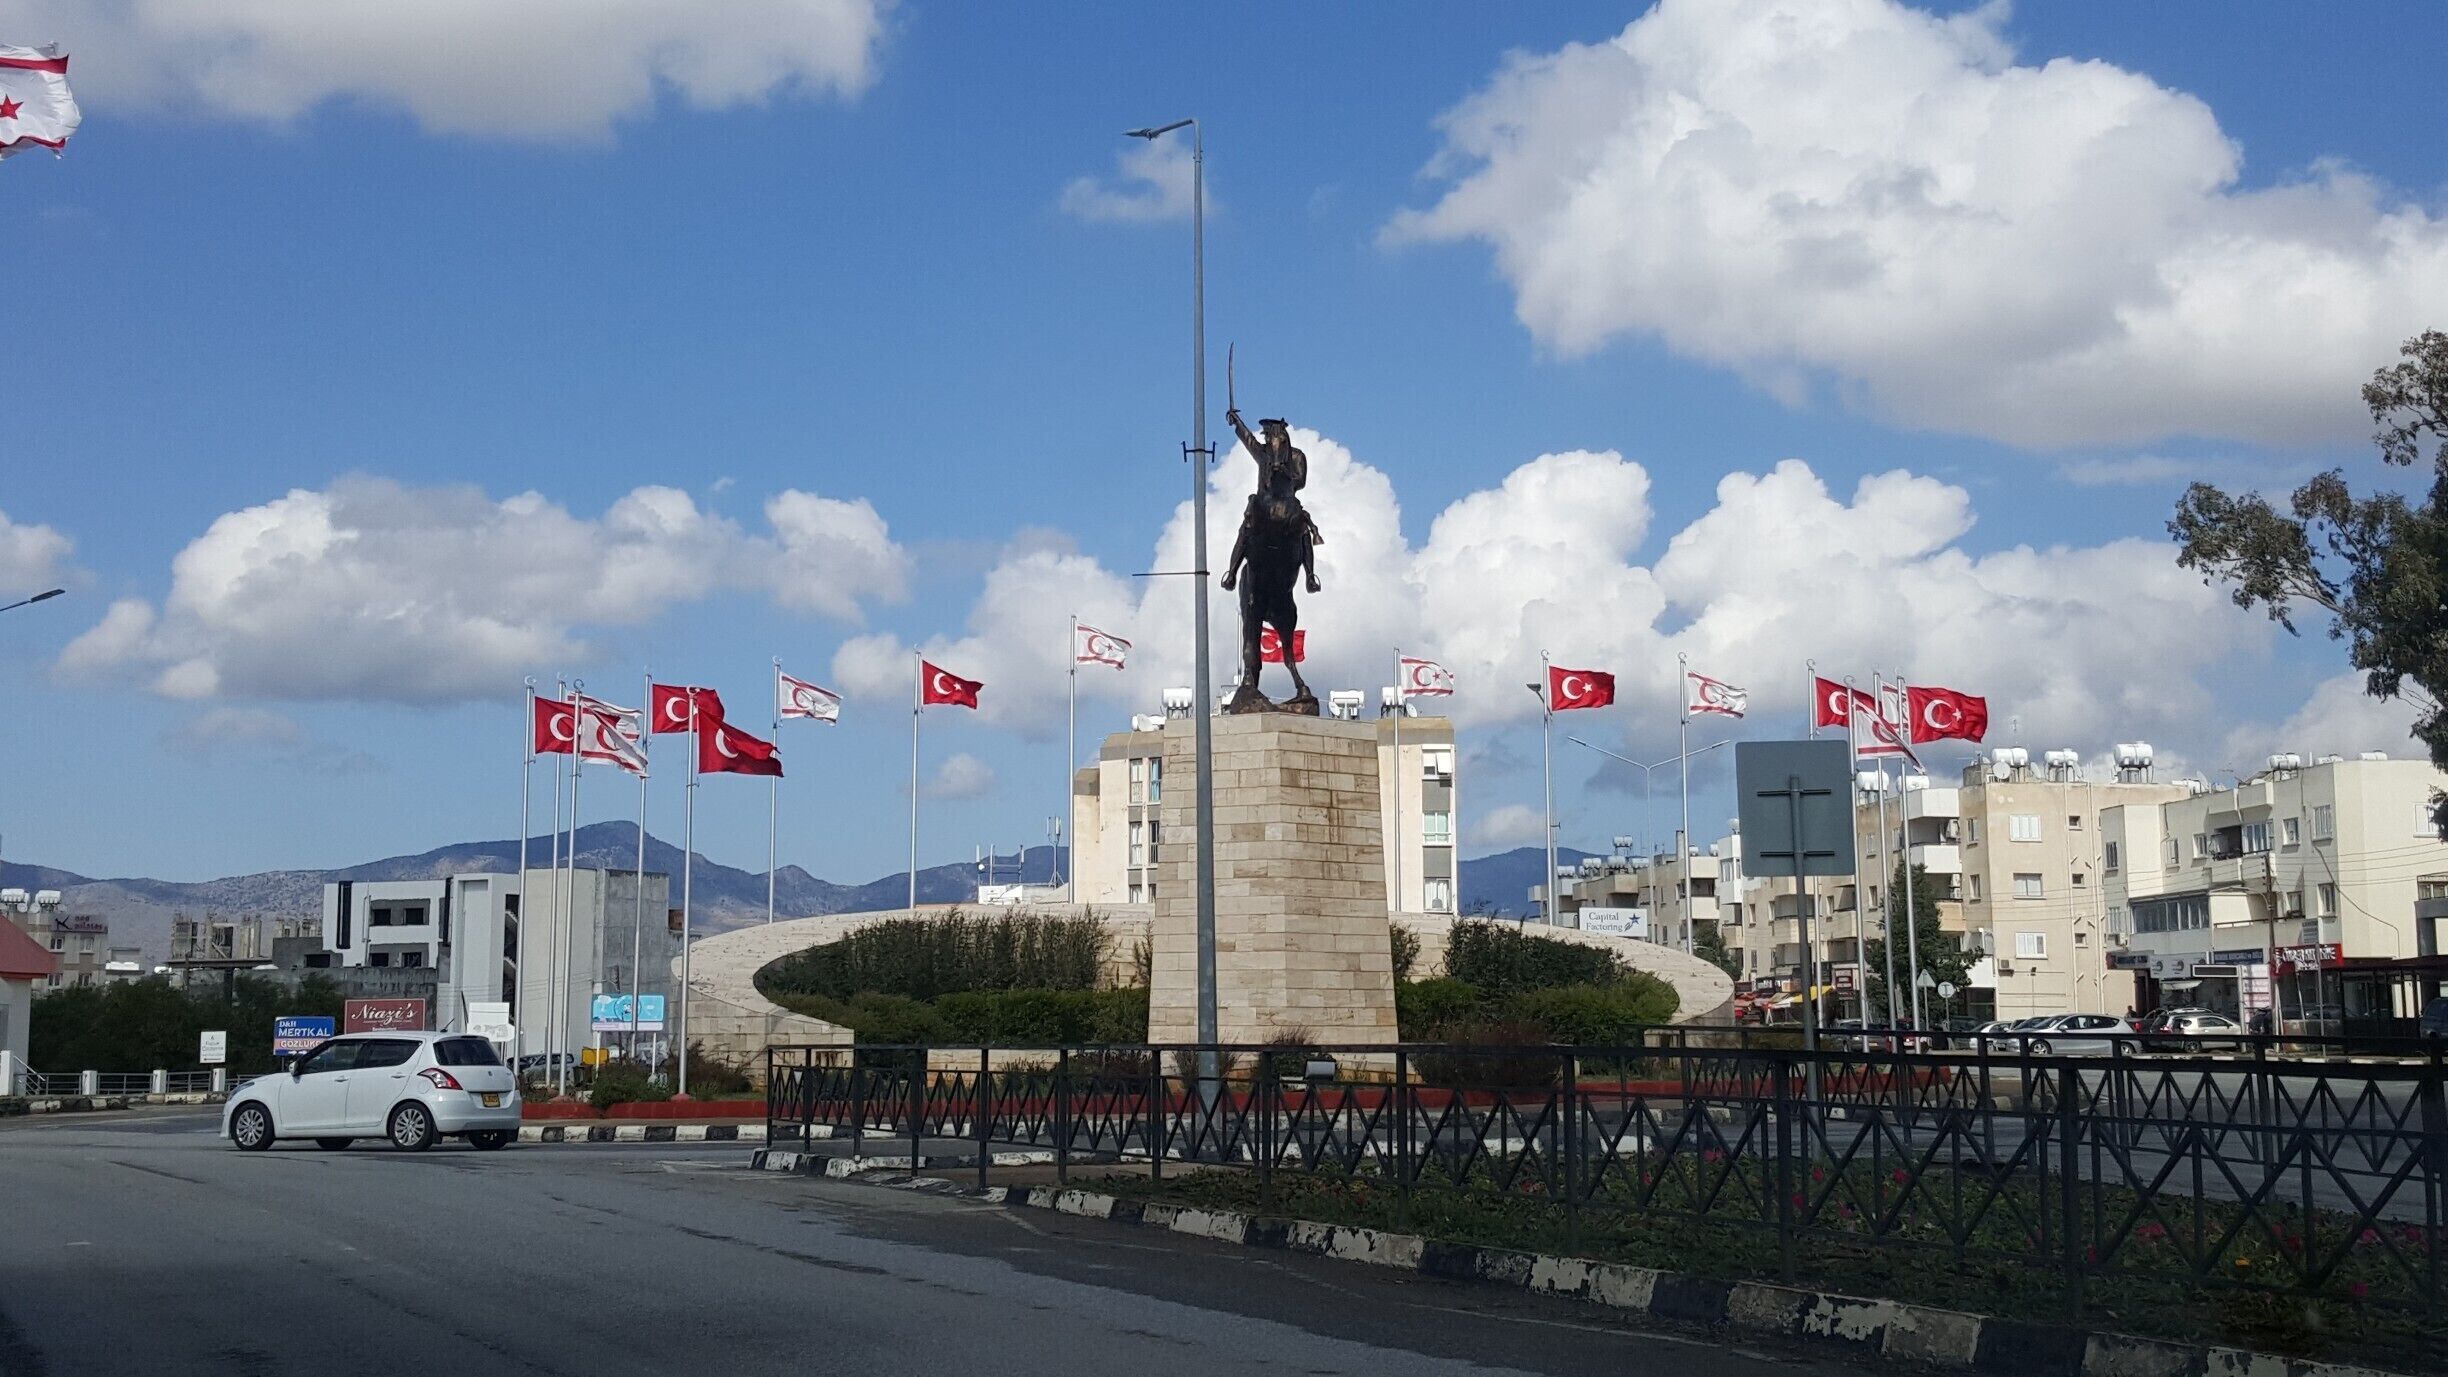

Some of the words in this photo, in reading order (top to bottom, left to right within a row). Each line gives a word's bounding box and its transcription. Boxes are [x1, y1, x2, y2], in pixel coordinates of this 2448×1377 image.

[1588, 911, 1619, 922] Capital
[1586, 922, 1623, 932] Factoring
[350, 1003, 417, 1025] Niazi's
[279, 1020, 297, 1028] D&H
[278, 1027, 331, 1037] MERTKAL
